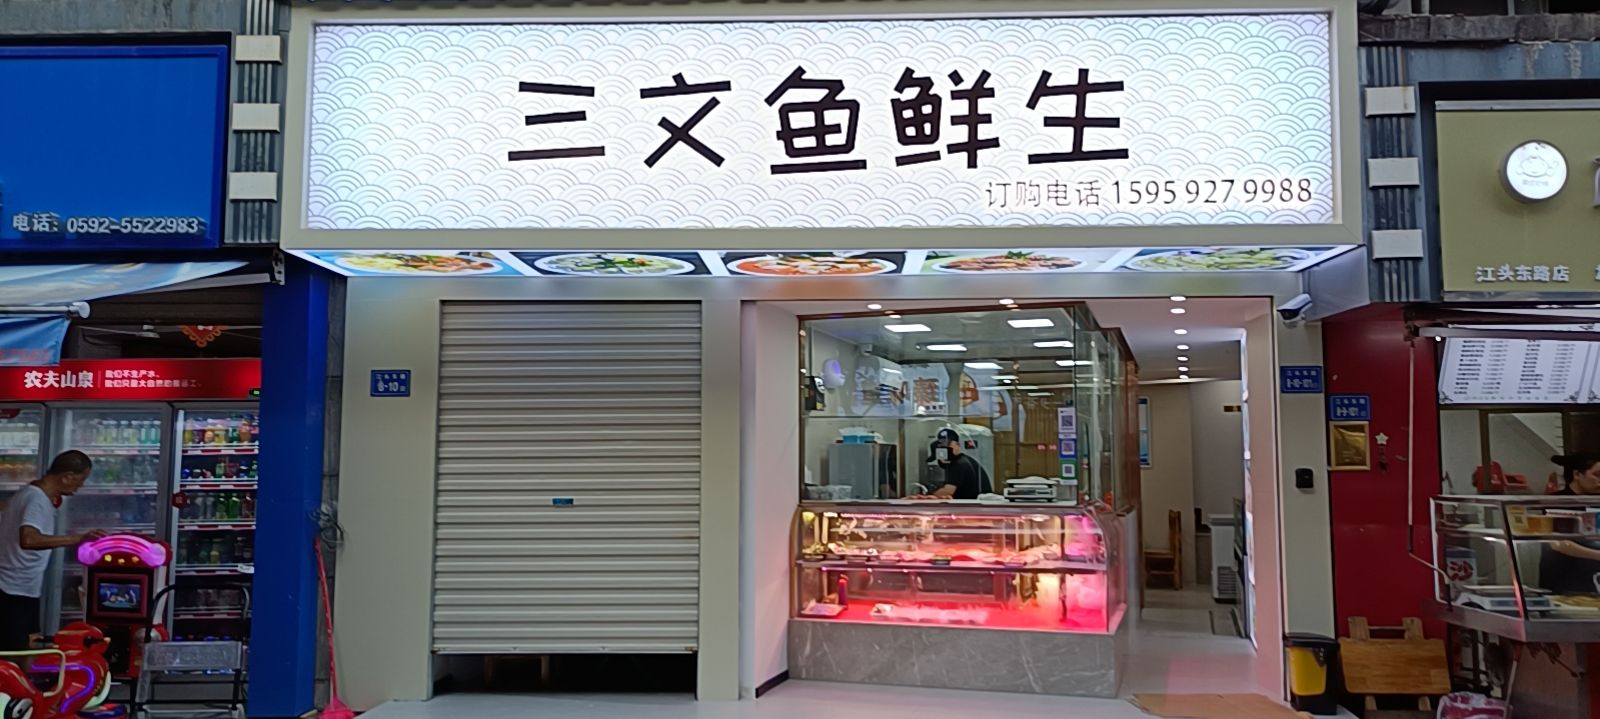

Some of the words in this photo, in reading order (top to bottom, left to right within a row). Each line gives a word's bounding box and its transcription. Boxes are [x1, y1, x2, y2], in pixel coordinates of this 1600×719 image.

[507, 65, 1129, 175] 三文鱼鲜生
[985, 178, 1101, 208] 订购电话
[1242, 177, 1313, 203] 9988
[66, 216, 199, 235] 0592-5522983
[1476, 263, 1570, 283] 江头东路店
[23, 369, 95, 389] 农夫山泉
